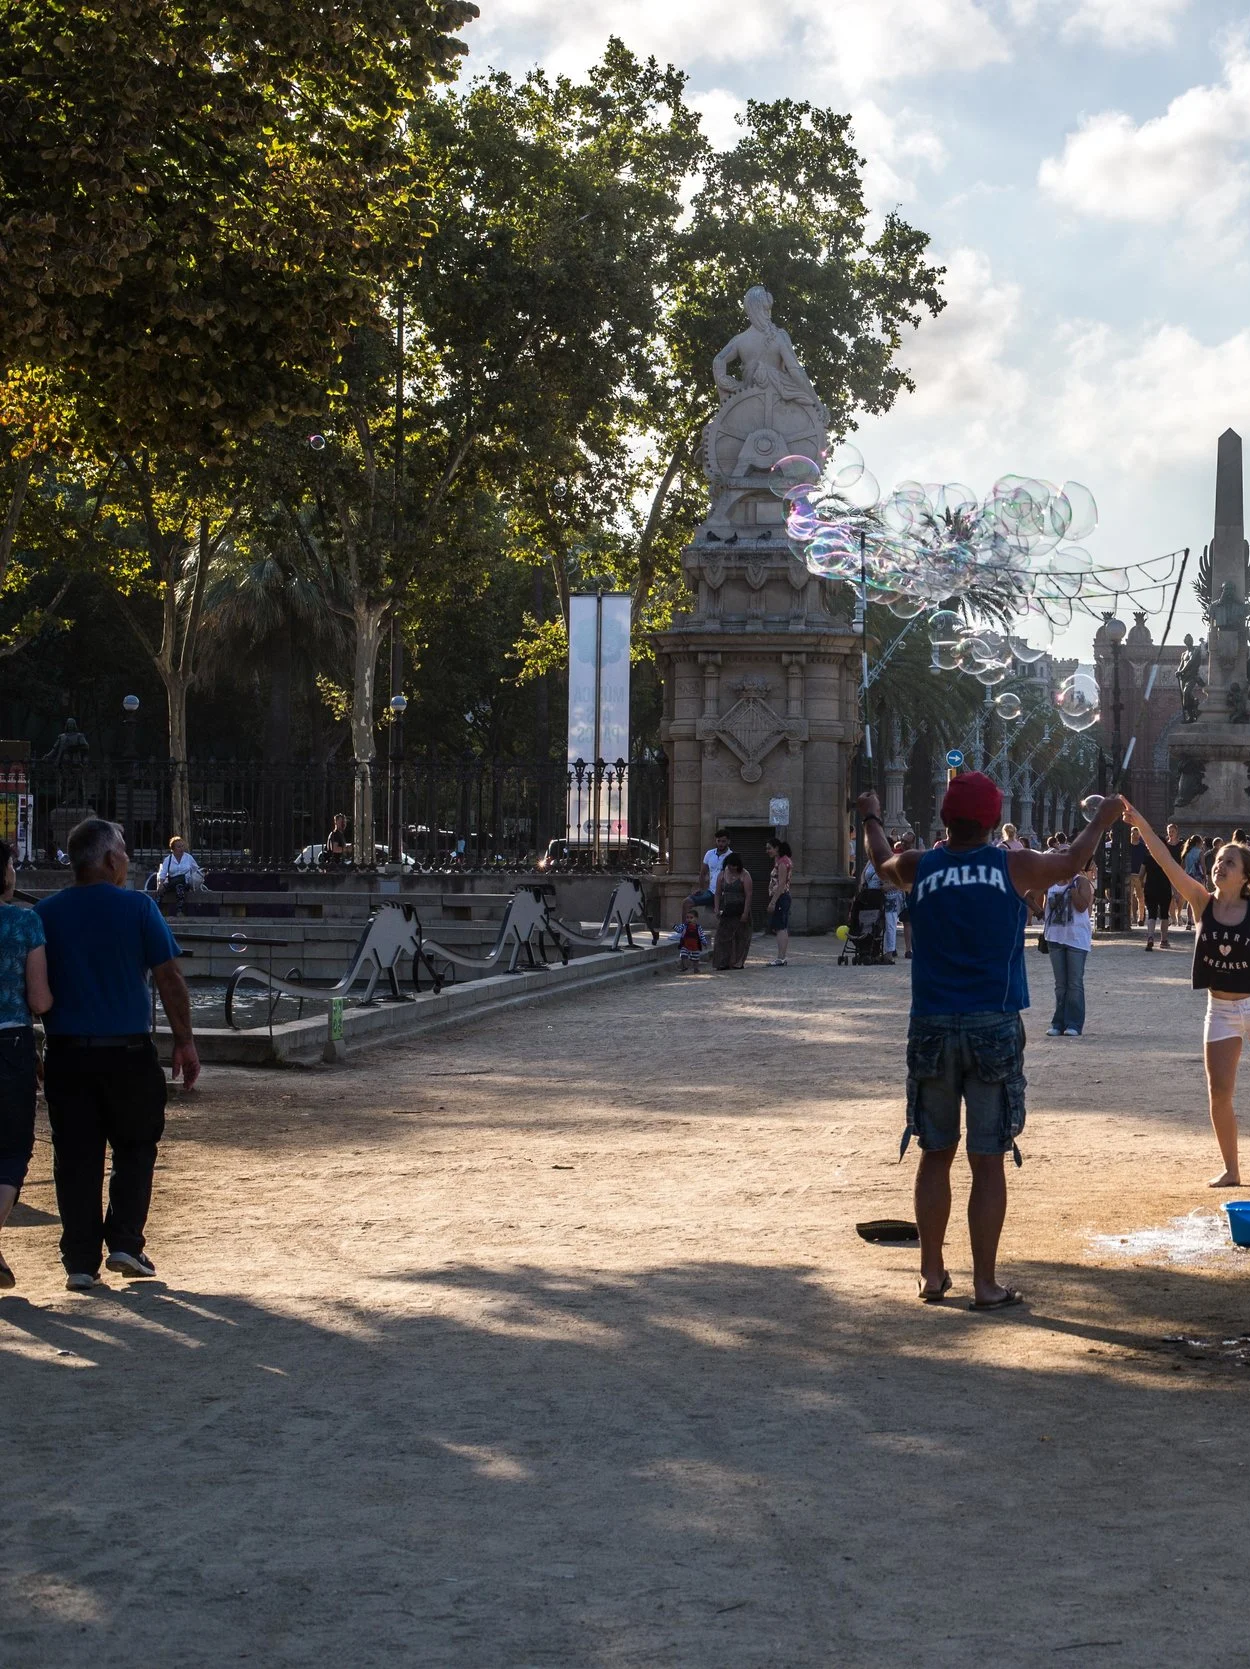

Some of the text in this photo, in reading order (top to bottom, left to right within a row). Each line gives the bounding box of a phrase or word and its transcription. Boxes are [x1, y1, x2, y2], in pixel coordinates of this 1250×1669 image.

[916, 864, 1007, 903] ITALIA
[1201, 931, 1250, 946] HEART
[1203, 955, 1249, 970] BREAKER
